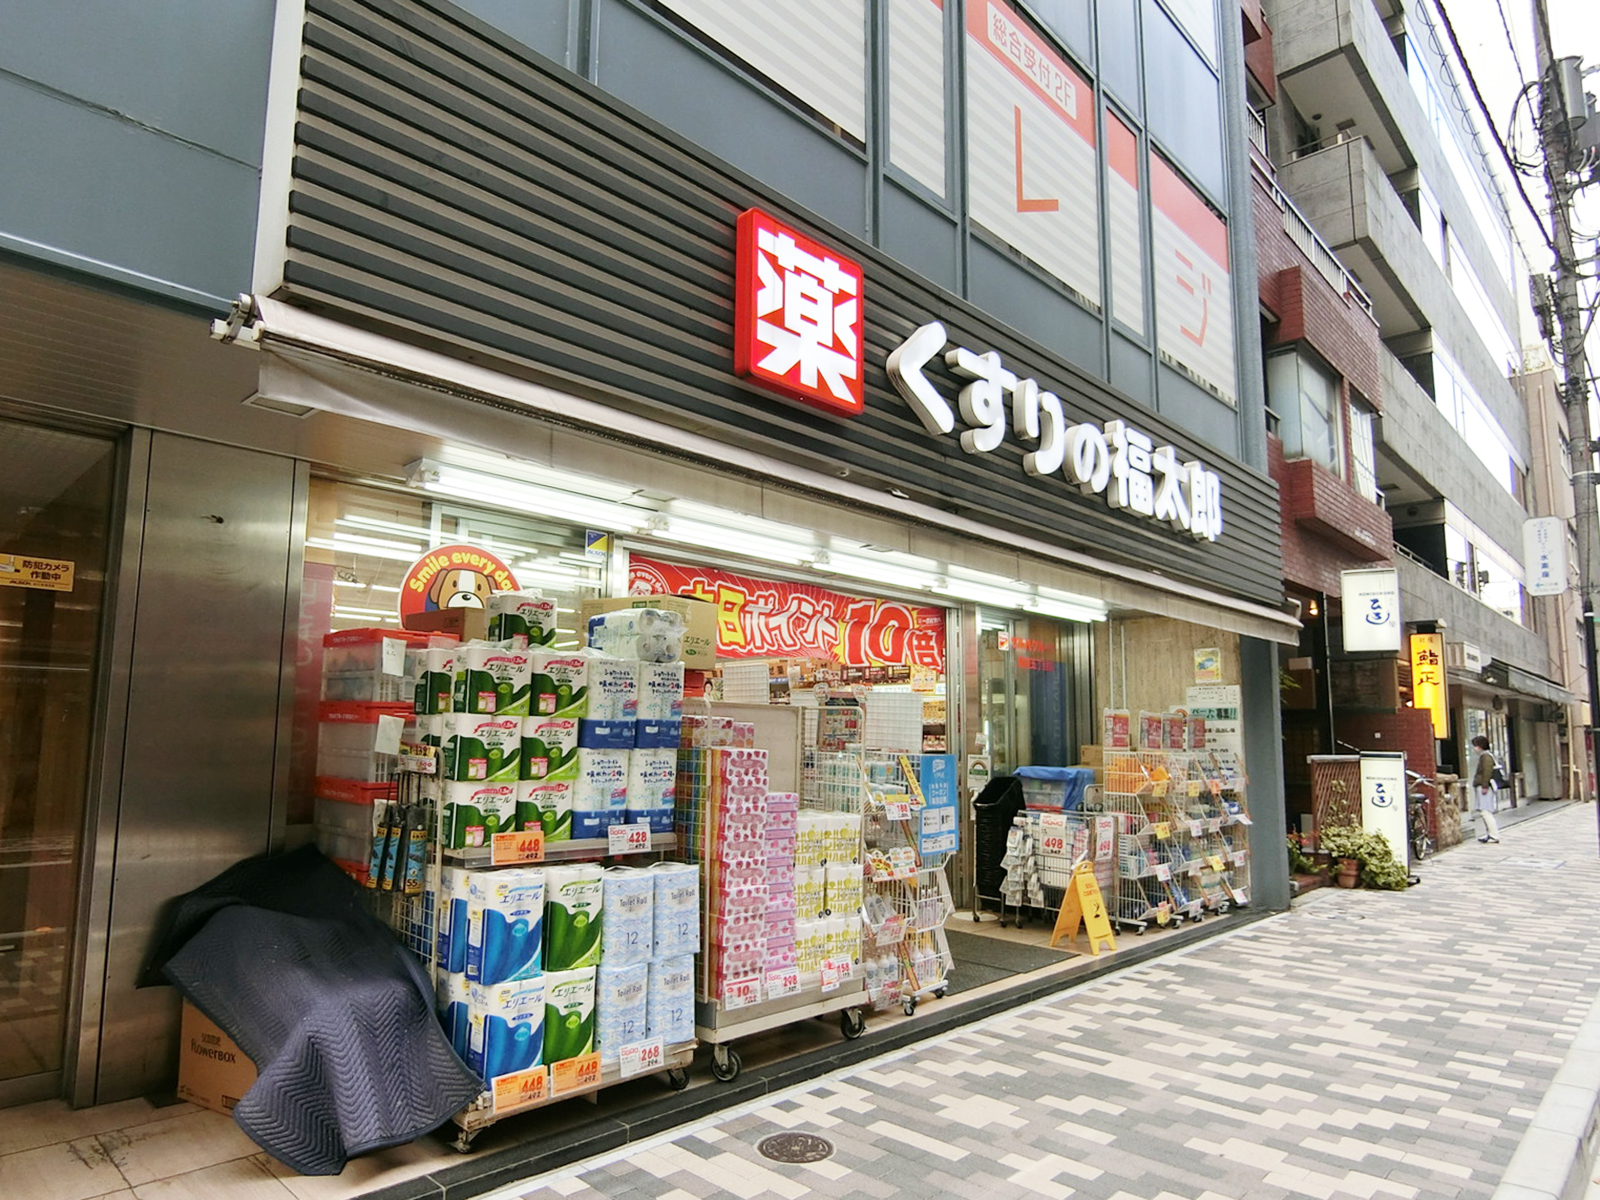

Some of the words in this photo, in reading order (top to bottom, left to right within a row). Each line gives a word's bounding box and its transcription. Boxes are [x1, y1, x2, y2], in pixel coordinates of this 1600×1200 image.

[757, 227, 857, 403] 薬
[886, 321, 1222, 541] くすりの福太郎
[23, 560, 69, 572] 防犯カメラ
[410, 555, 449, 592] Smile
[451, 552, 496, 575] every
[495, 571, 514, 591] da
[30, 571, 61, 580] 作動中
[519, 608, 551, 617] エリエール
[487, 664, 525, 673] エリエール
[547, 666, 583, 675] エリエール
[1416, 649, 1440, 685] 鮨正
[478, 730, 516, 738] エリエール
[538, 729, 574, 737] エリエール
[474, 796, 511, 804] エリエール
[533, 793, 567, 801] エリエール
[629, 832, 647, 843] 428
[1045, 838, 1063, 849] 498
[520, 838, 540, 852] 448
[562, 885, 600, 897] エリエール
[671, 891, 685, 900] Toilet
[685, 889, 695, 897] Roll
[500, 892, 541, 904] エリエール
[620, 899, 636, 907] Toilet
[636, 896, 647, 904] Roll
[677, 922, 689, 936] 12
[626, 931, 639, 945] 12
[664, 977, 679, 986] Toilet
[679, 974, 690, 982] Roll
[783, 975, 798, 987] 298
[554, 984, 593, 998] エリエール
[617, 987, 632, 997] Toilet
[632, 984, 642, 993] Roll
[736, 985, 750, 998] 10
[502, 994, 543, 1009] エリエール
[671, 1008, 683, 1022] 12
[623, 1020, 635, 1035] 12
[641, 1045, 660, 1062] 268
[578, 1060, 598, 1077] 448
[522, 1075, 543, 1093] 448
